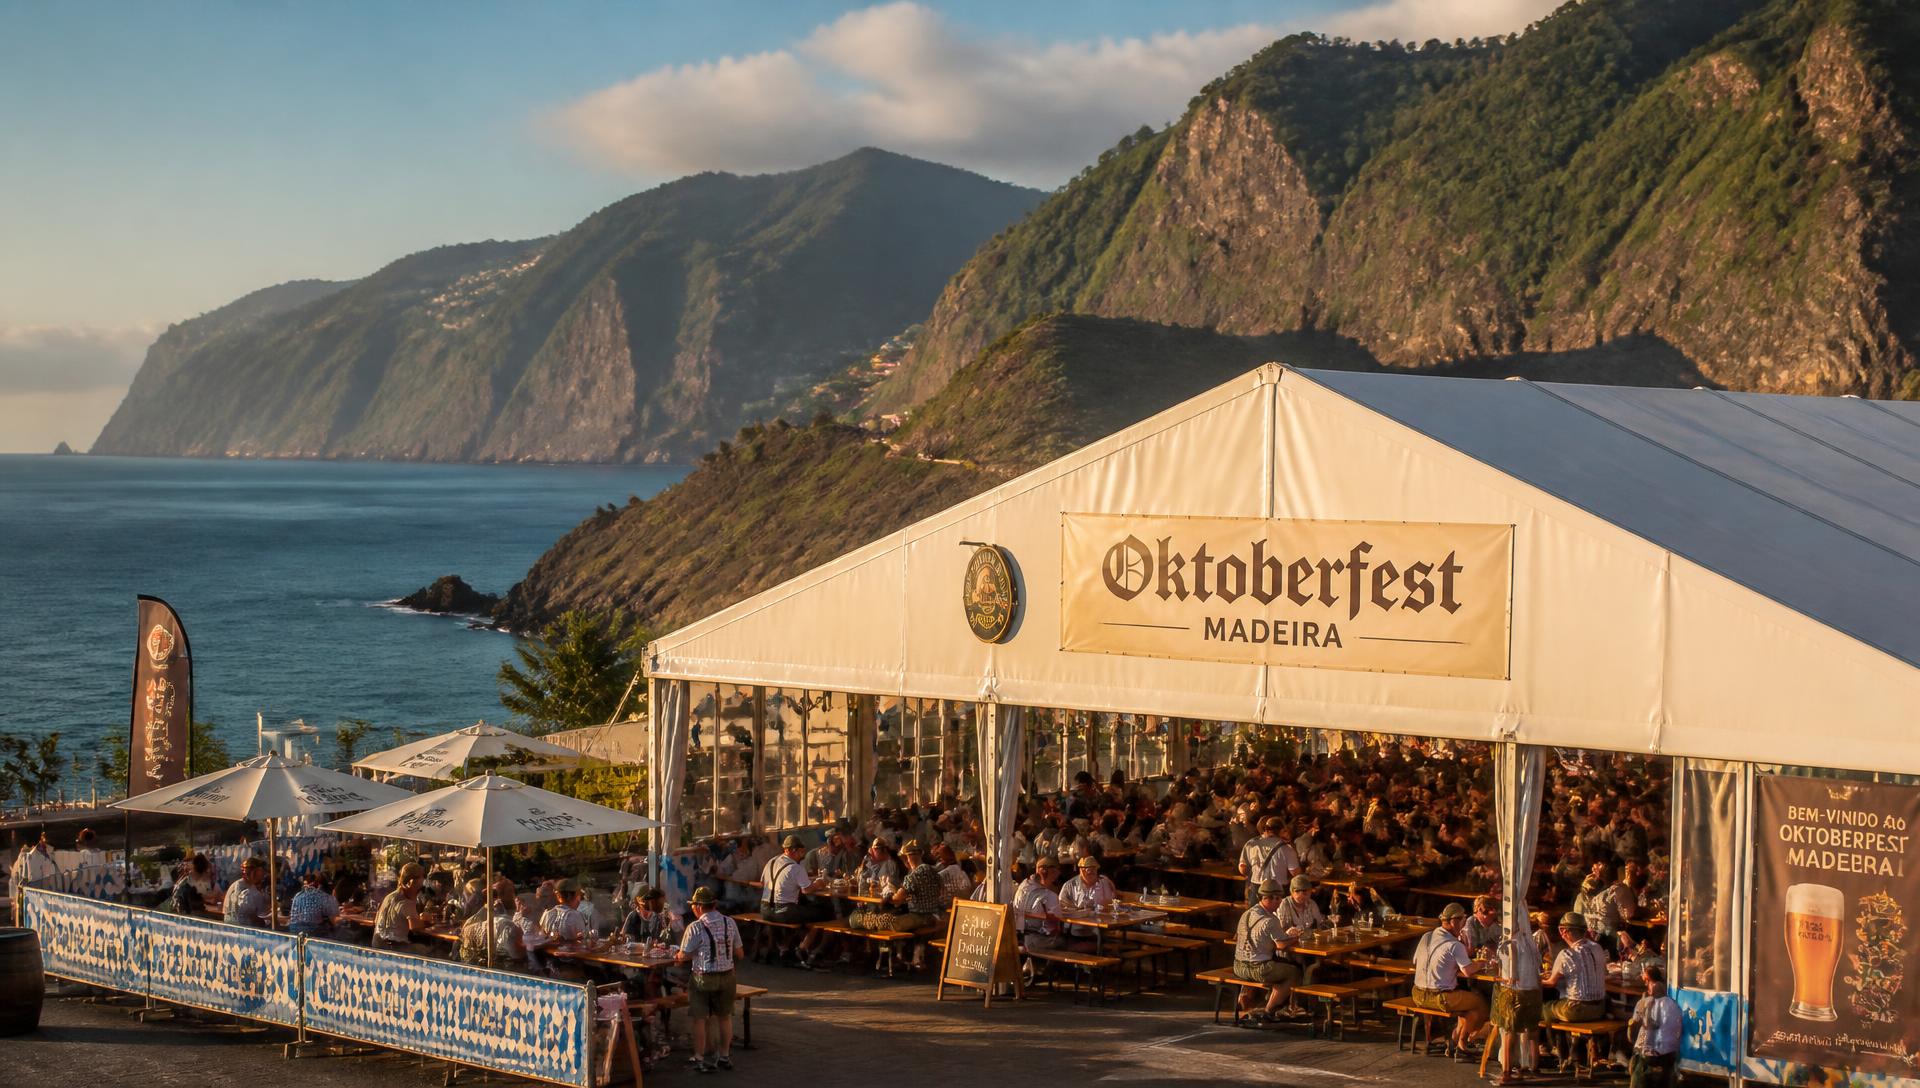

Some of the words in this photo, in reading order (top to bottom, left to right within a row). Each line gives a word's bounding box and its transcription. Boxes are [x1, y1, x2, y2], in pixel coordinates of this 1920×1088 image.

[1102, 534, 1464, 621] Oktoberfest
[1204, 617, 1343, 649] MADEIRA
[1788, 805, 1878, 828] BEM-VINIDO
